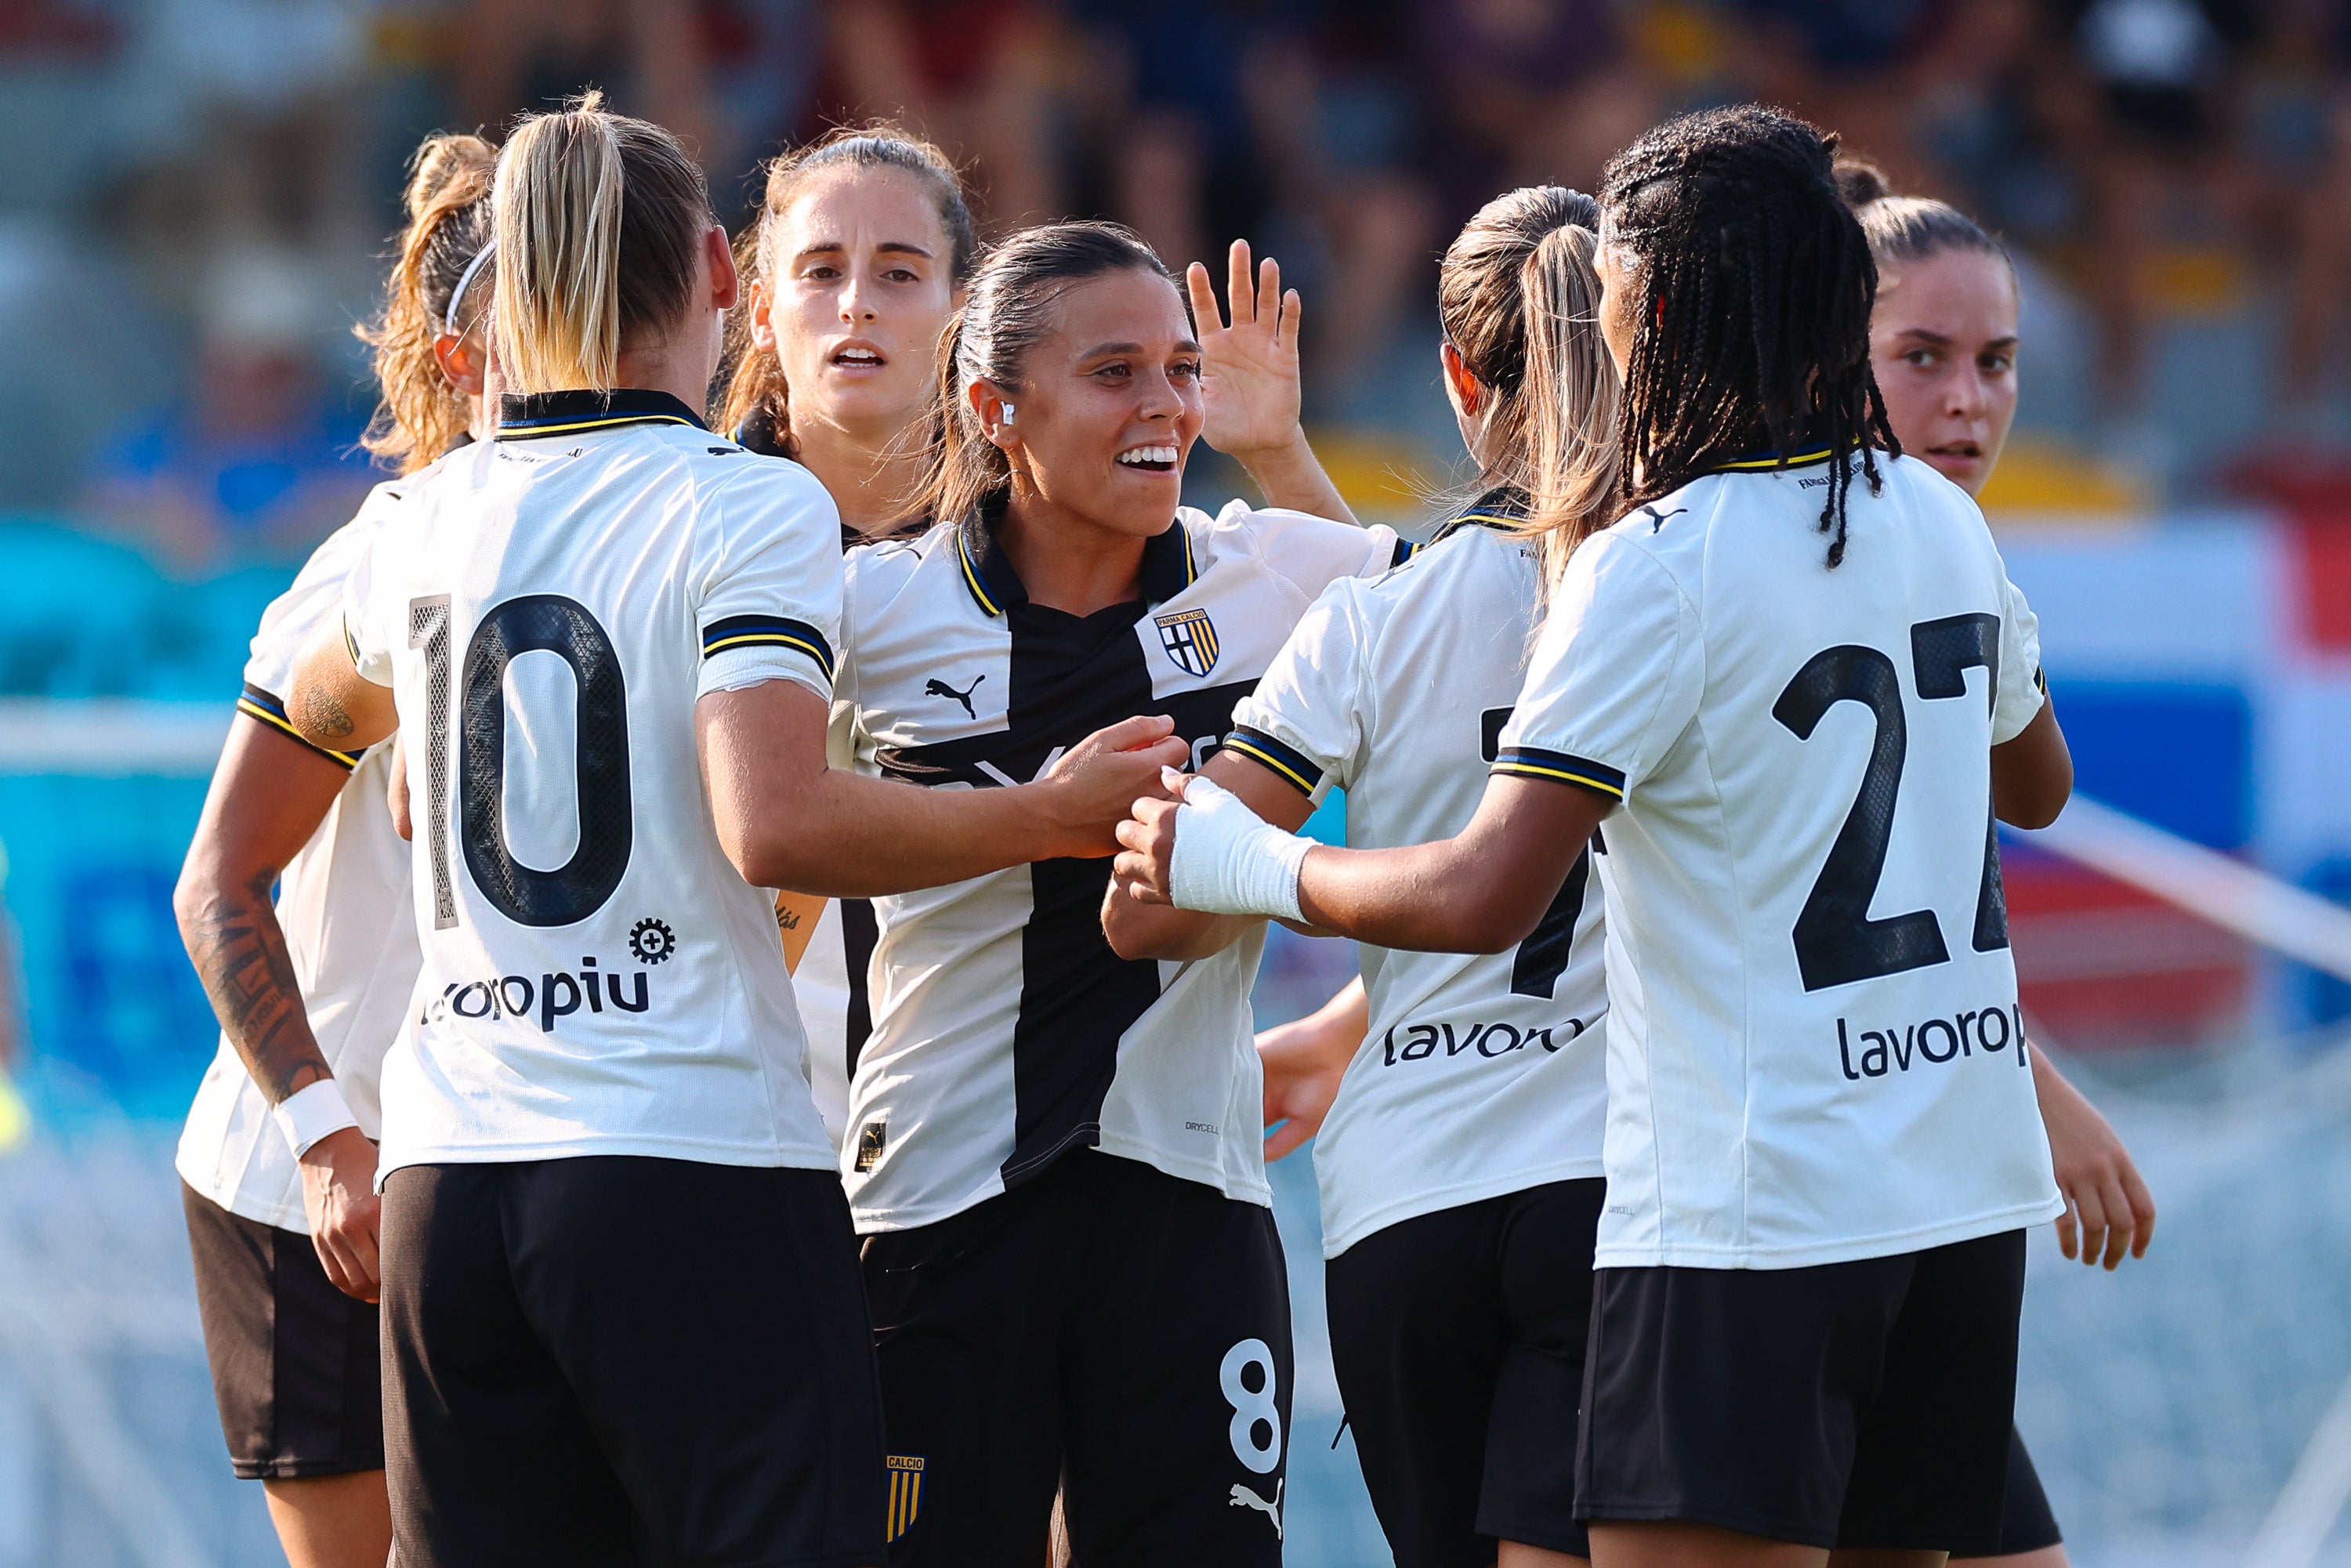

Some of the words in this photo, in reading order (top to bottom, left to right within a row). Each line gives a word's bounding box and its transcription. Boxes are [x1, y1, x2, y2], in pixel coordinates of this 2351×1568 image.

[1157, 616, 1181, 626] PARMA
[1181, 611, 1204, 621] CALCIO
[408, 592, 633, 930] 10
[1771, 611, 2010, 994] 27
[1185, 1121, 1219, 1135] DRYCELL
[1219, 1338, 1282, 1474] 8
[889, 1457, 923, 1469] CALCIO
